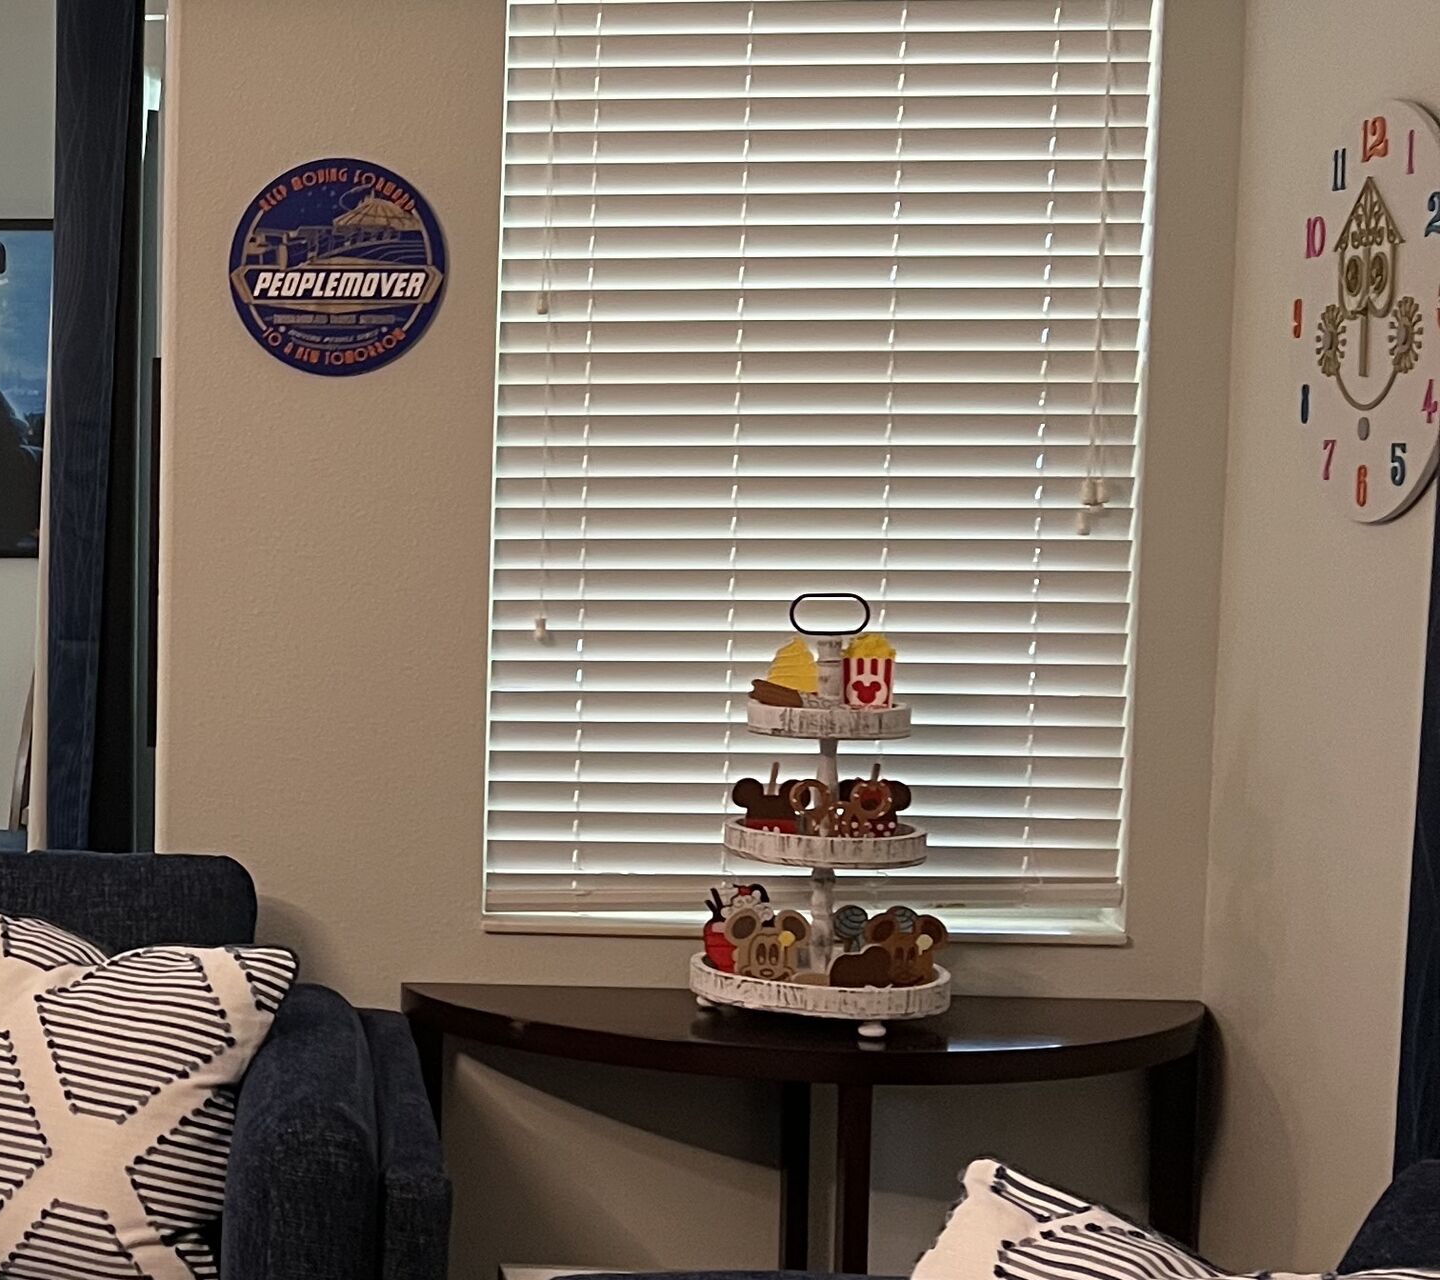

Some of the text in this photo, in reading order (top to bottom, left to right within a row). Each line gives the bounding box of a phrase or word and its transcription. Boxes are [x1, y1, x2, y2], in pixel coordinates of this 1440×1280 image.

[1361, 116, 1389, 163] 12
[1406, 129, 1415, 175] 1
[291, 168, 348, 191] MOVING
[1332, 148, 1347, 192] 11
[1305, 216, 1327, 259] 10
[253, 272, 427, 298] PEOPLEMOVER
[1421, 378, 1439, 424] 4
[1323, 439, 1337, 480] 7
[1390, 443, 1407, 486] 5
[1356, 464, 1368, 507] 6
